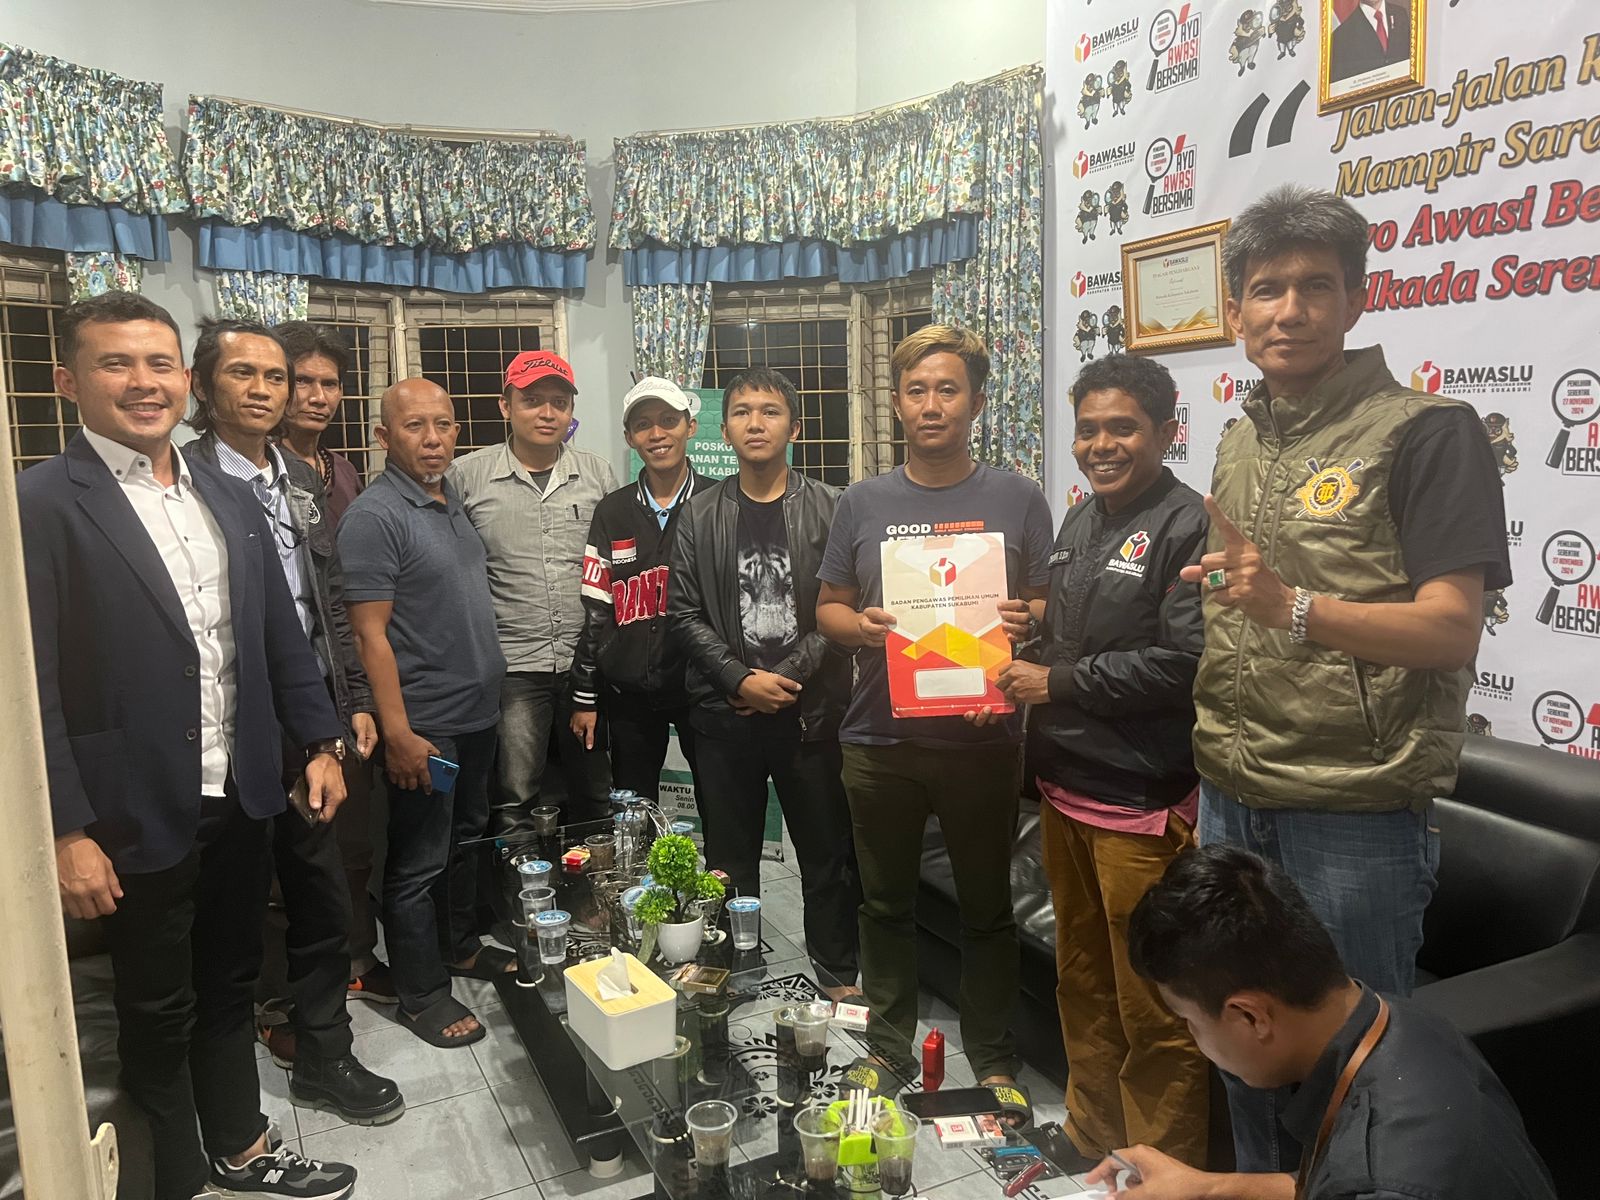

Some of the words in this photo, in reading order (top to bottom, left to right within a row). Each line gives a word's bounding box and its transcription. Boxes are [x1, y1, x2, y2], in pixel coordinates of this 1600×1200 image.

[1092, 17, 1139, 48] BAWASLU
[1181, 18, 1199, 42] AYO
[1168, 38, 1199, 67] AWASI
[1156, 58, 1198, 90] BERSAMA
[1089, 141, 1136, 166] BAWASLU
[1176, 149, 1195, 172] AYO
[1335, 132, 1496, 199] Mampir
[1164, 169, 1194, 193] AWASI
[1152, 188, 1193, 215] BERSAMA
[1402, 185, 1538, 249] Awasi
[1362, 261, 1480, 313] lkada
[1443, 365, 1533, 385] BAWASLU
[686, 454, 719, 464] ANAN
[886, 523, 931, 535] GOOD
[1108, 558, 1145, 572] BAWASLU
[911, 602, 947, 610] KABUPATEN
[947, 600, 979, 608] SUKABUMI
[659, 785, 691, 795] WAKTU
[262, 1169, 284, 1184] N
